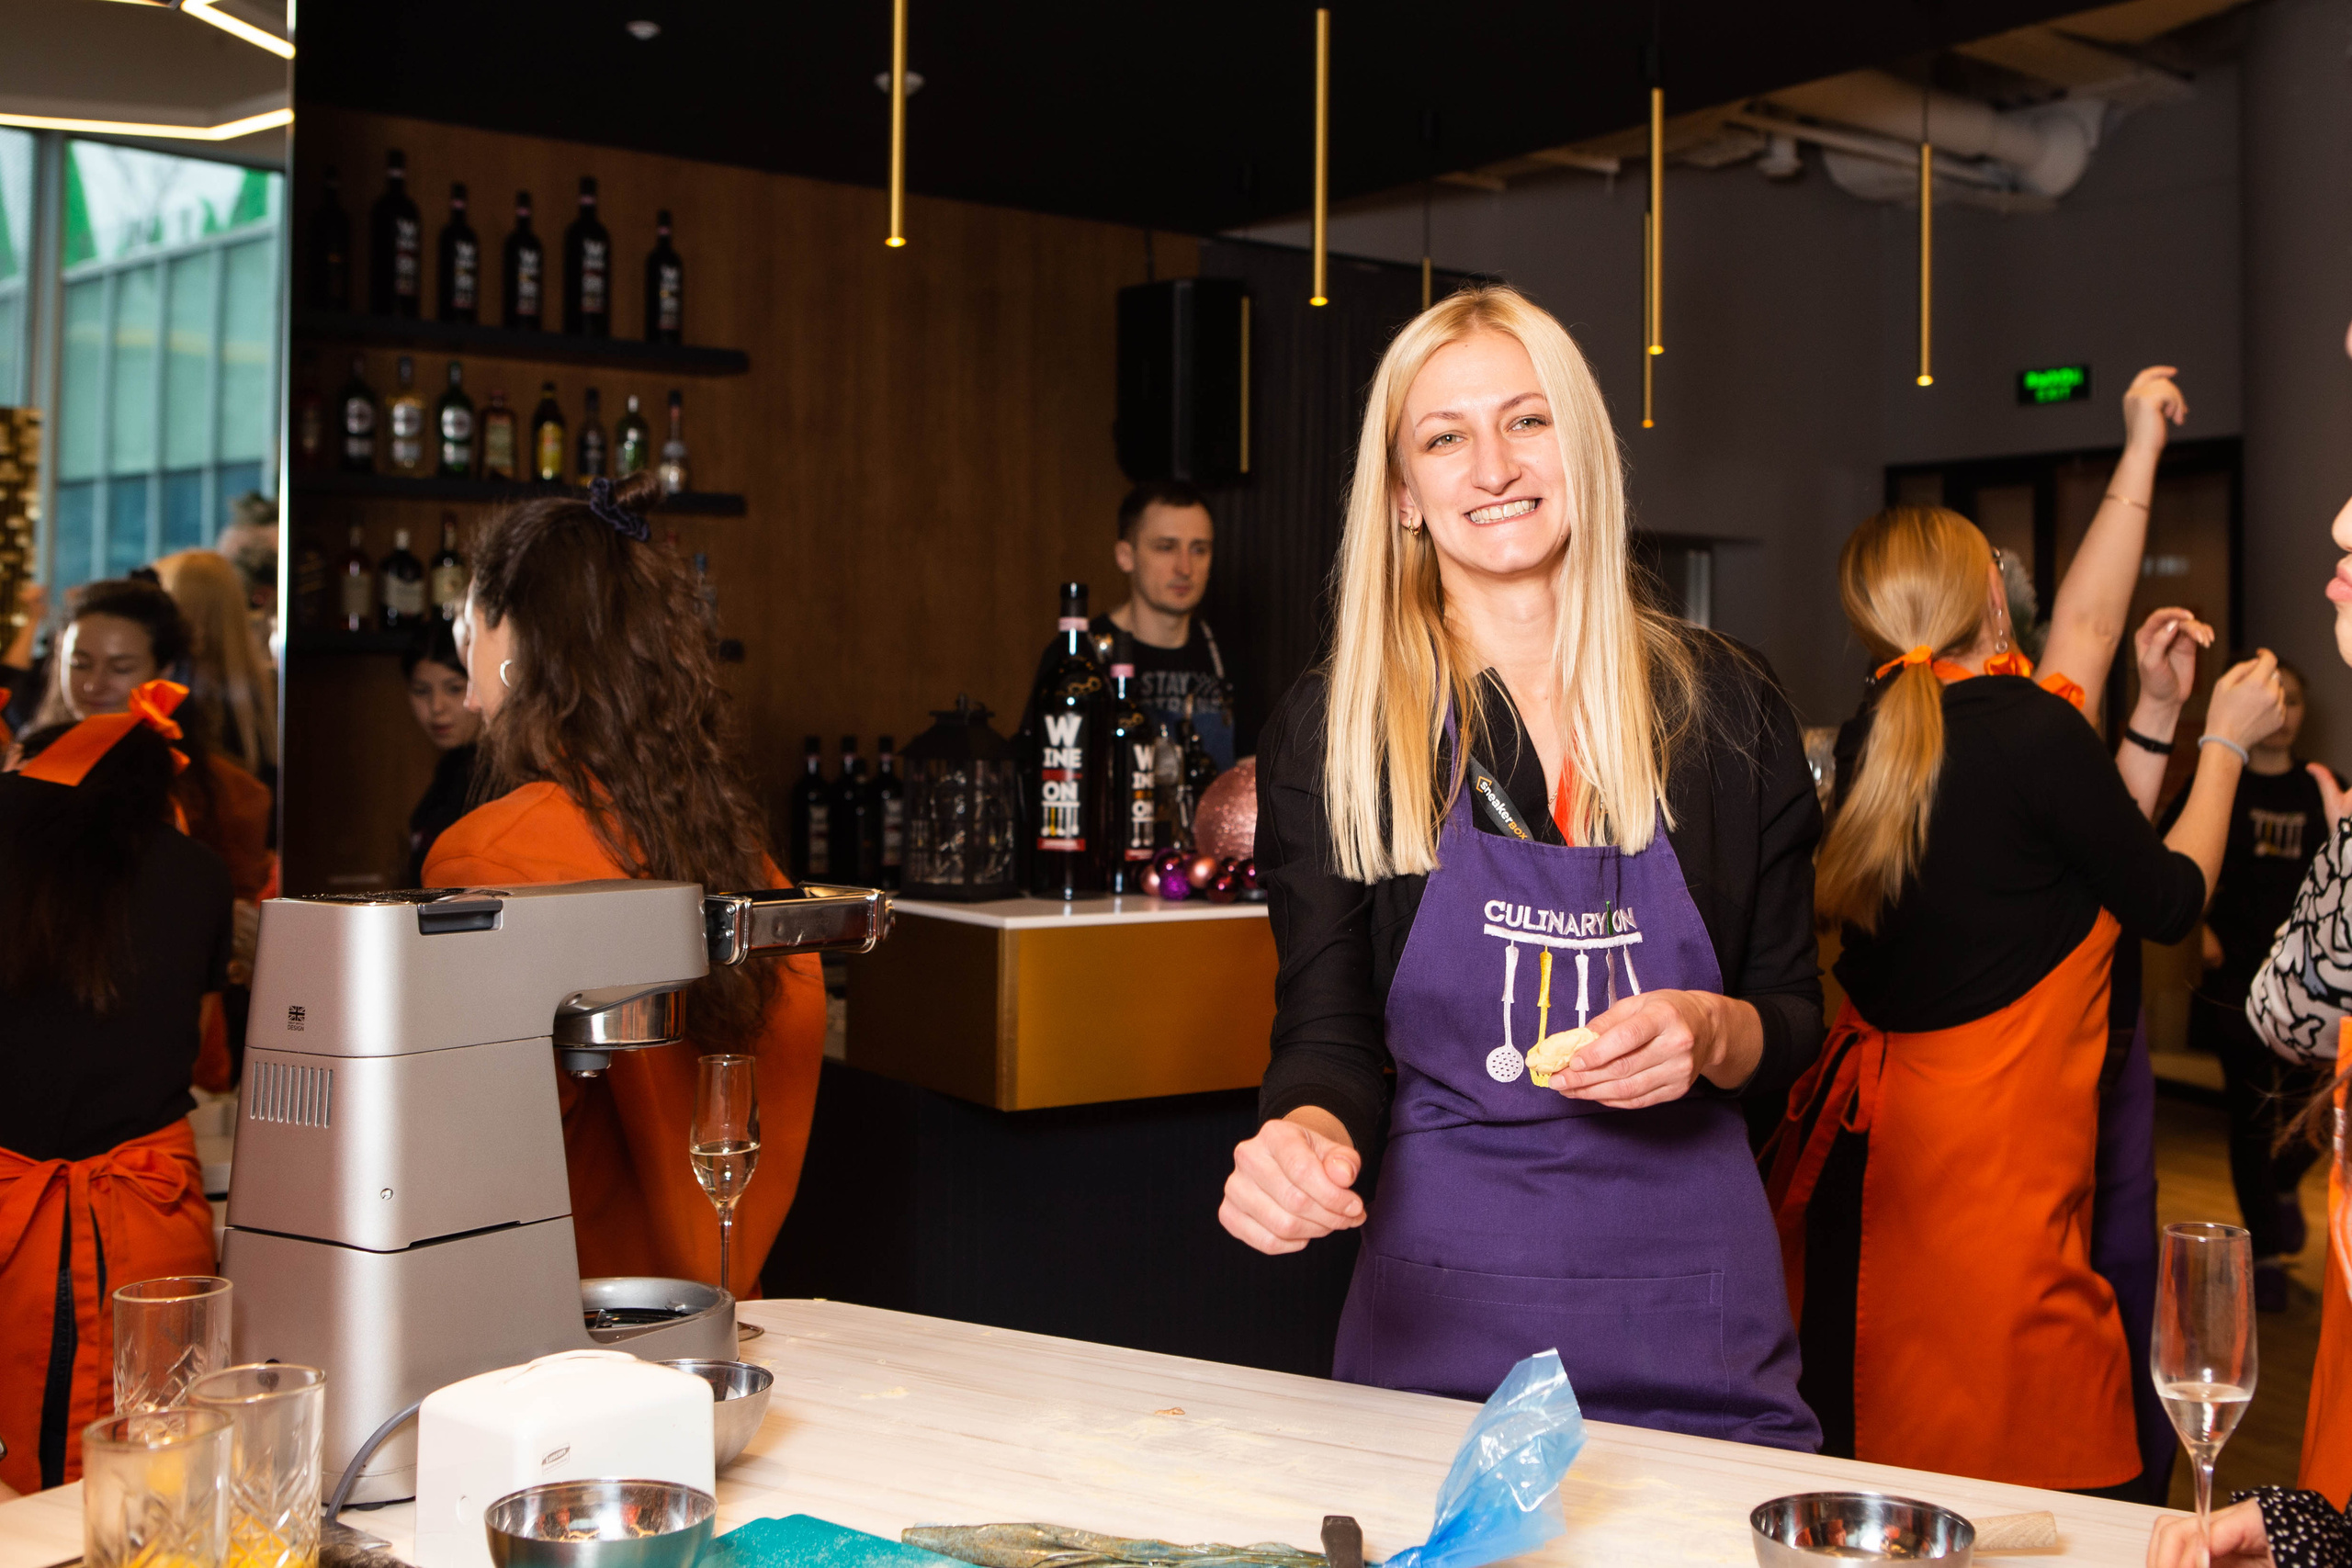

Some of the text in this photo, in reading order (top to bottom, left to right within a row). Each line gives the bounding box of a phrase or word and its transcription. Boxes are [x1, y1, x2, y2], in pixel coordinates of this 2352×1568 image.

[1141, 671, 1191, 695] STAY
[1045, 715, 1082, 747] W
[1044, 748, 1082, 768] INE
[1043, 781, 1078, 802] ON
[1132, 772, 1155, 789] IN
[1484, 899, 1638, 937] CULINARY ON
